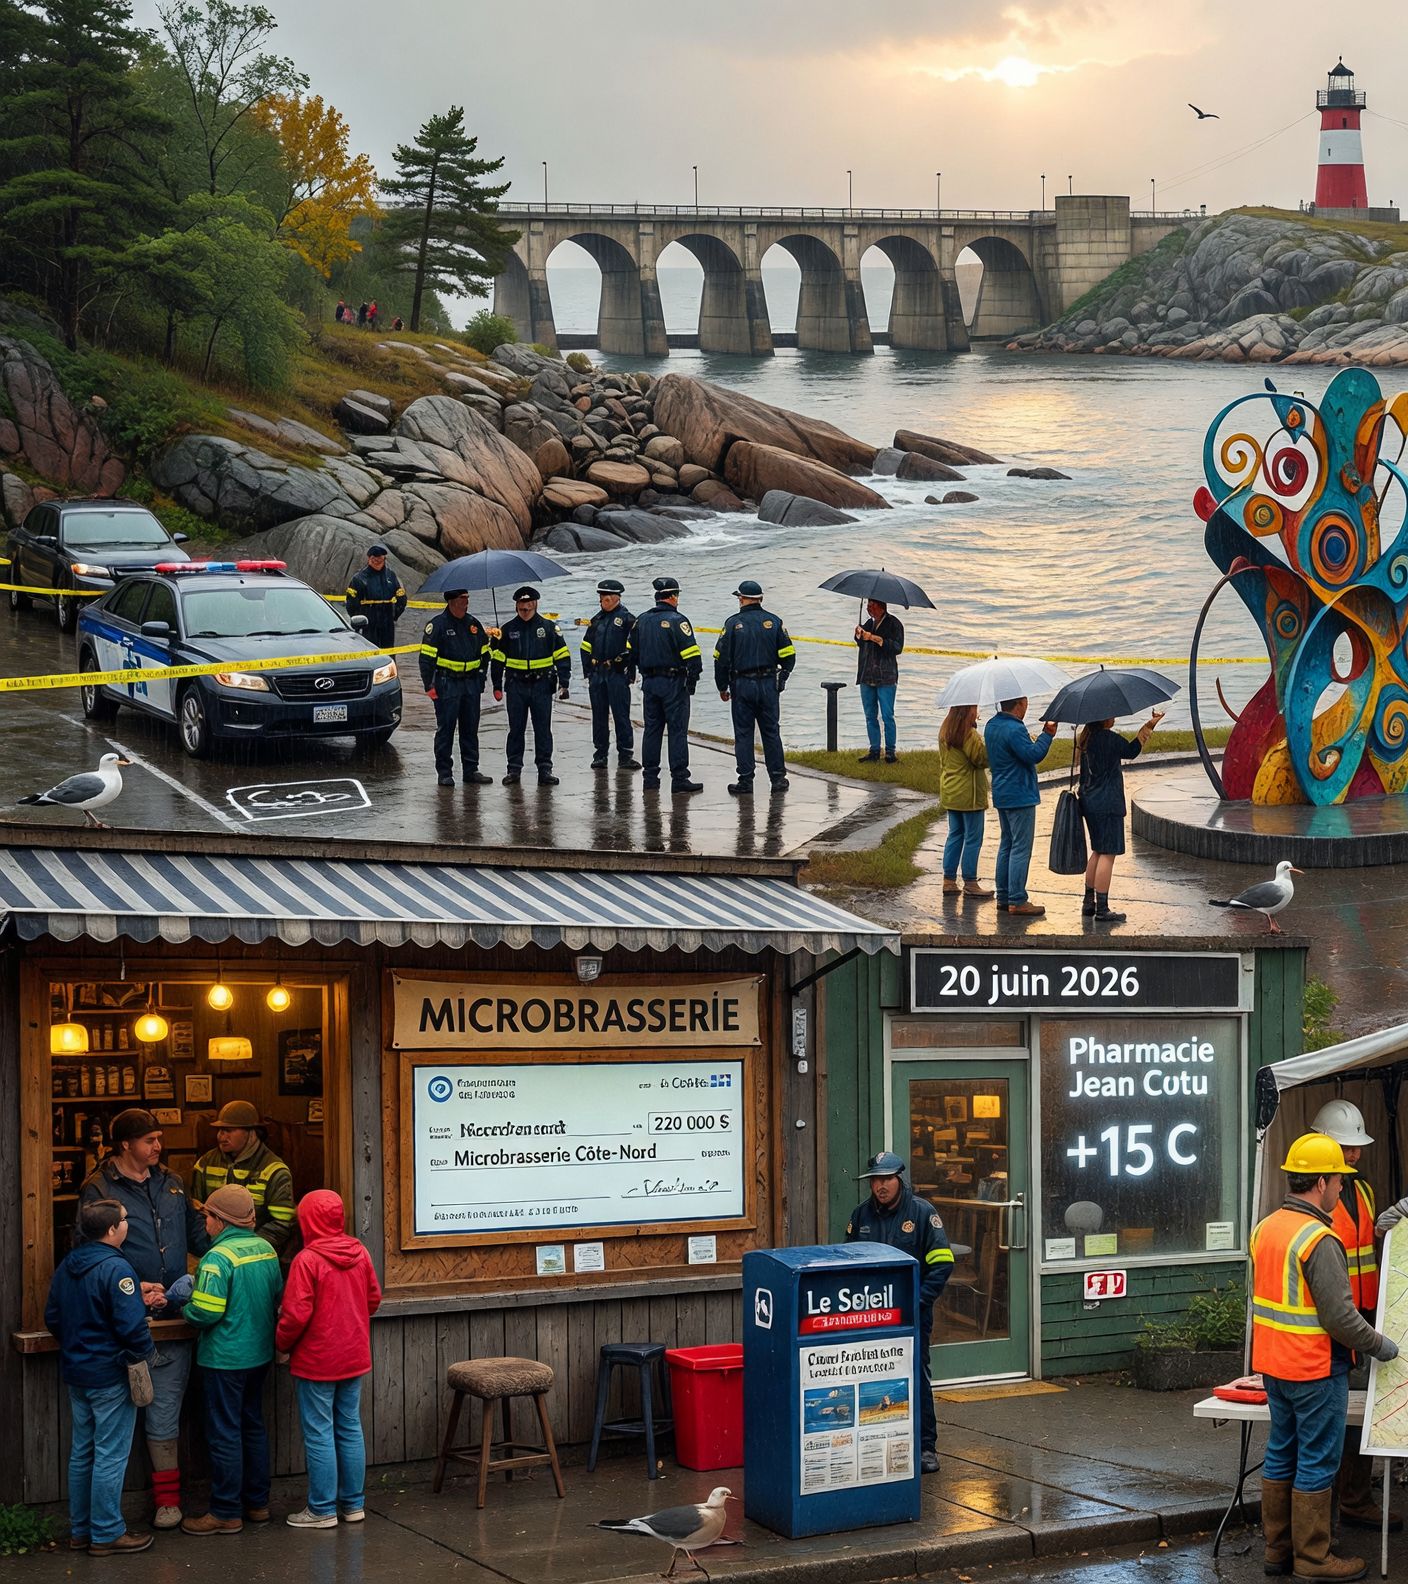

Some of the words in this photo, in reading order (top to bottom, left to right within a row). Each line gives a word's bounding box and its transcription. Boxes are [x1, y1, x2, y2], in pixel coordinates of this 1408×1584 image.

[938, 965, 982, 997] 20
[987, 964, 1050, 1005] juin
[1060, 966, 1140, 997] 2026
[1069, 1036, 1215, 1065] Pharmacie
[1068, 1070, 1135, 1098] Jean
[654, 1116, 682, 1131] 220
[686, 1115, 715, 1130] 000
[454, 1146, 571, 1167] Microbrasserie
[575, 1142, 657, 1162] Côte-Nord
[1066, 1124, 1155, 1178] +15
[807, 1290, 832, 1315] Le
[838, 1284, 894, 1312] Soleil
